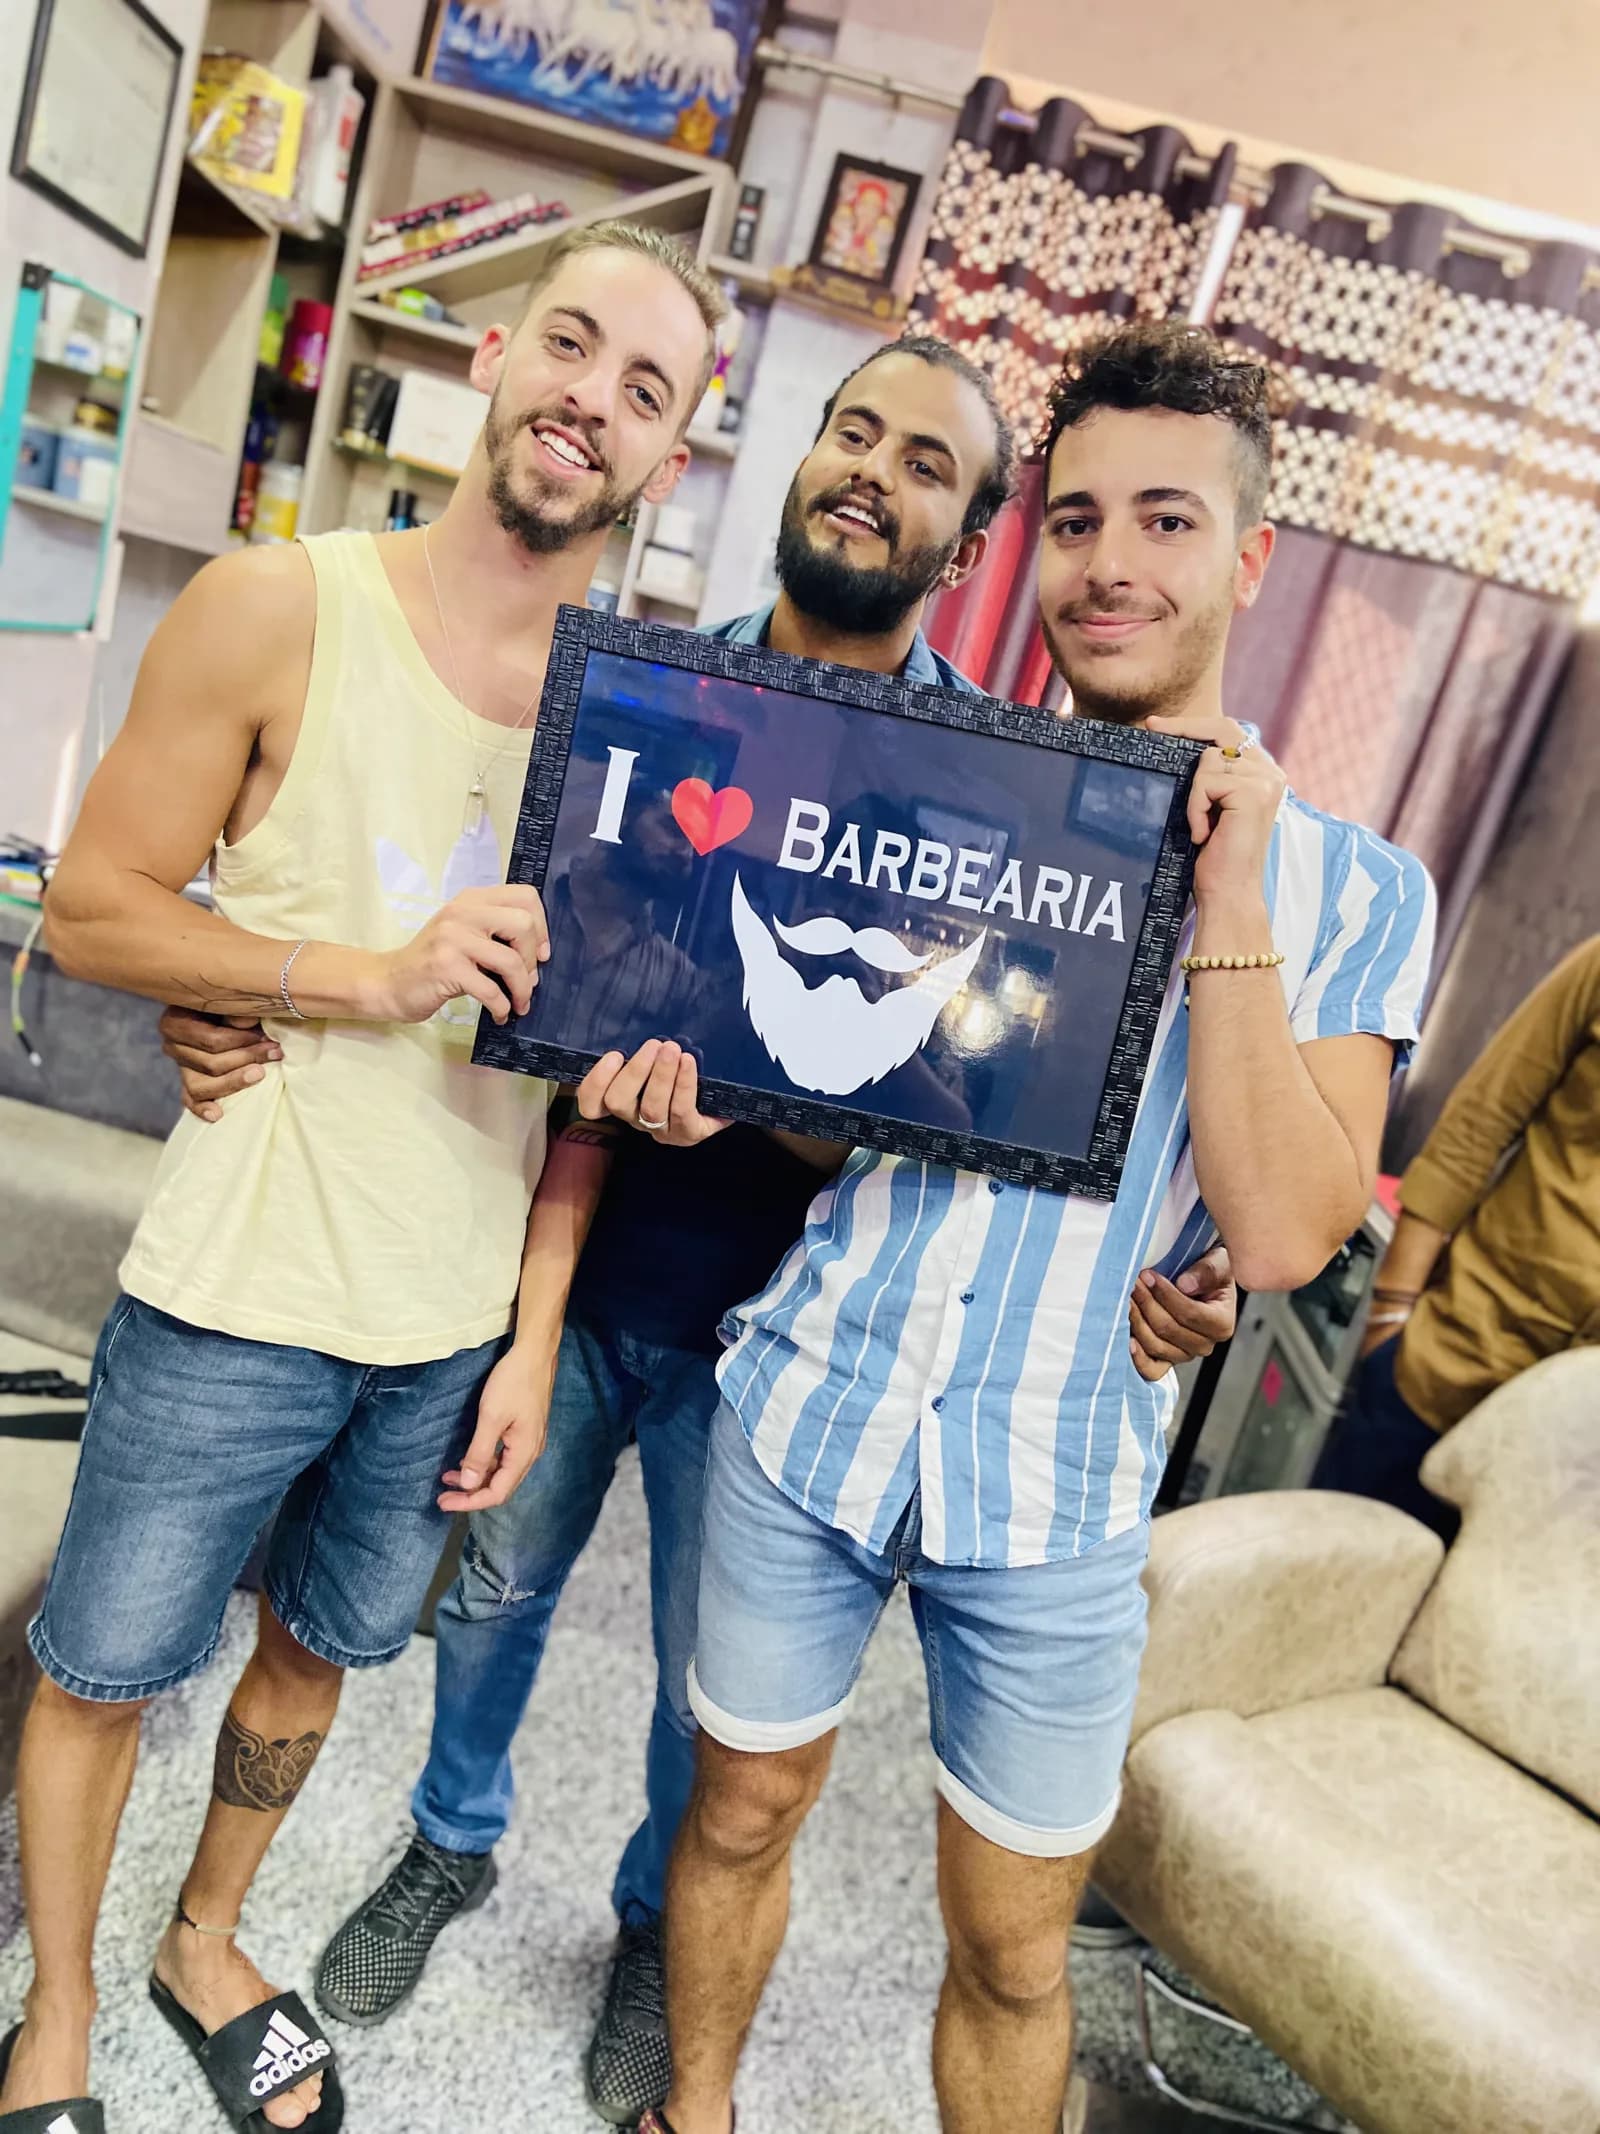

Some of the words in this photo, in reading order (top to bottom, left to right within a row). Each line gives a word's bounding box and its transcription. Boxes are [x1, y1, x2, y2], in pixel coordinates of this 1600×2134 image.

[589, 745, 641, 845] I
[776, 797, 1126, 943] BARBEARIA
[249, 2037, 331, 2097] adidas
